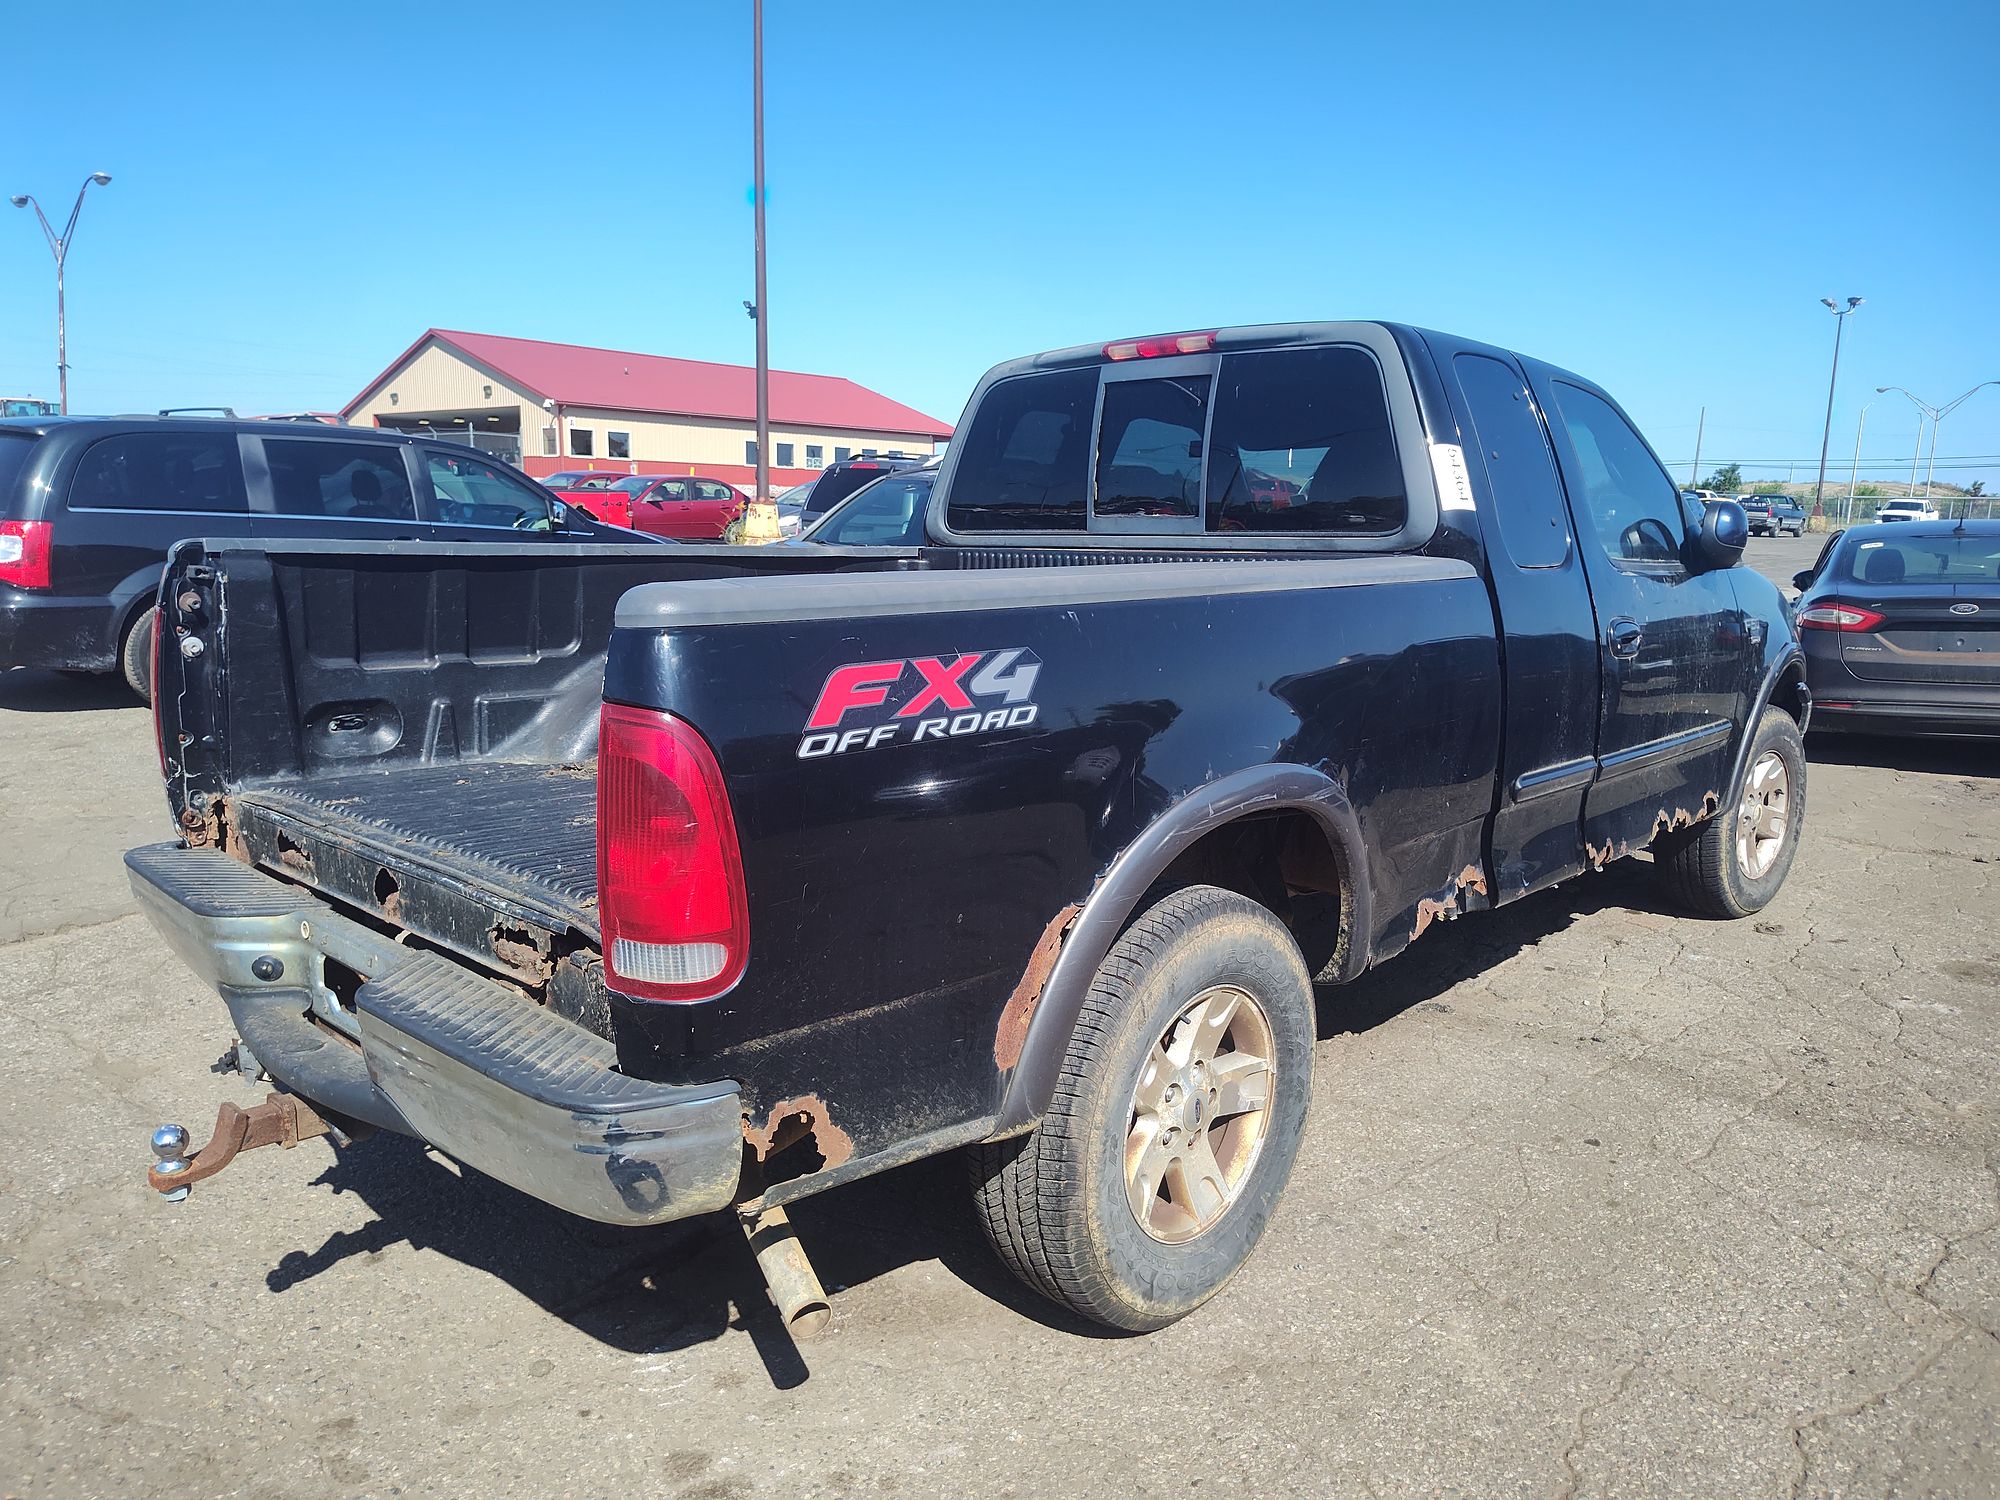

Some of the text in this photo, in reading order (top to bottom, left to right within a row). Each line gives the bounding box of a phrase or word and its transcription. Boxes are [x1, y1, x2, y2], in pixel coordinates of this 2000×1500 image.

[805, 649, 1041, 731] FX4
[797, 705, 1039, 759] OFF ROAD
